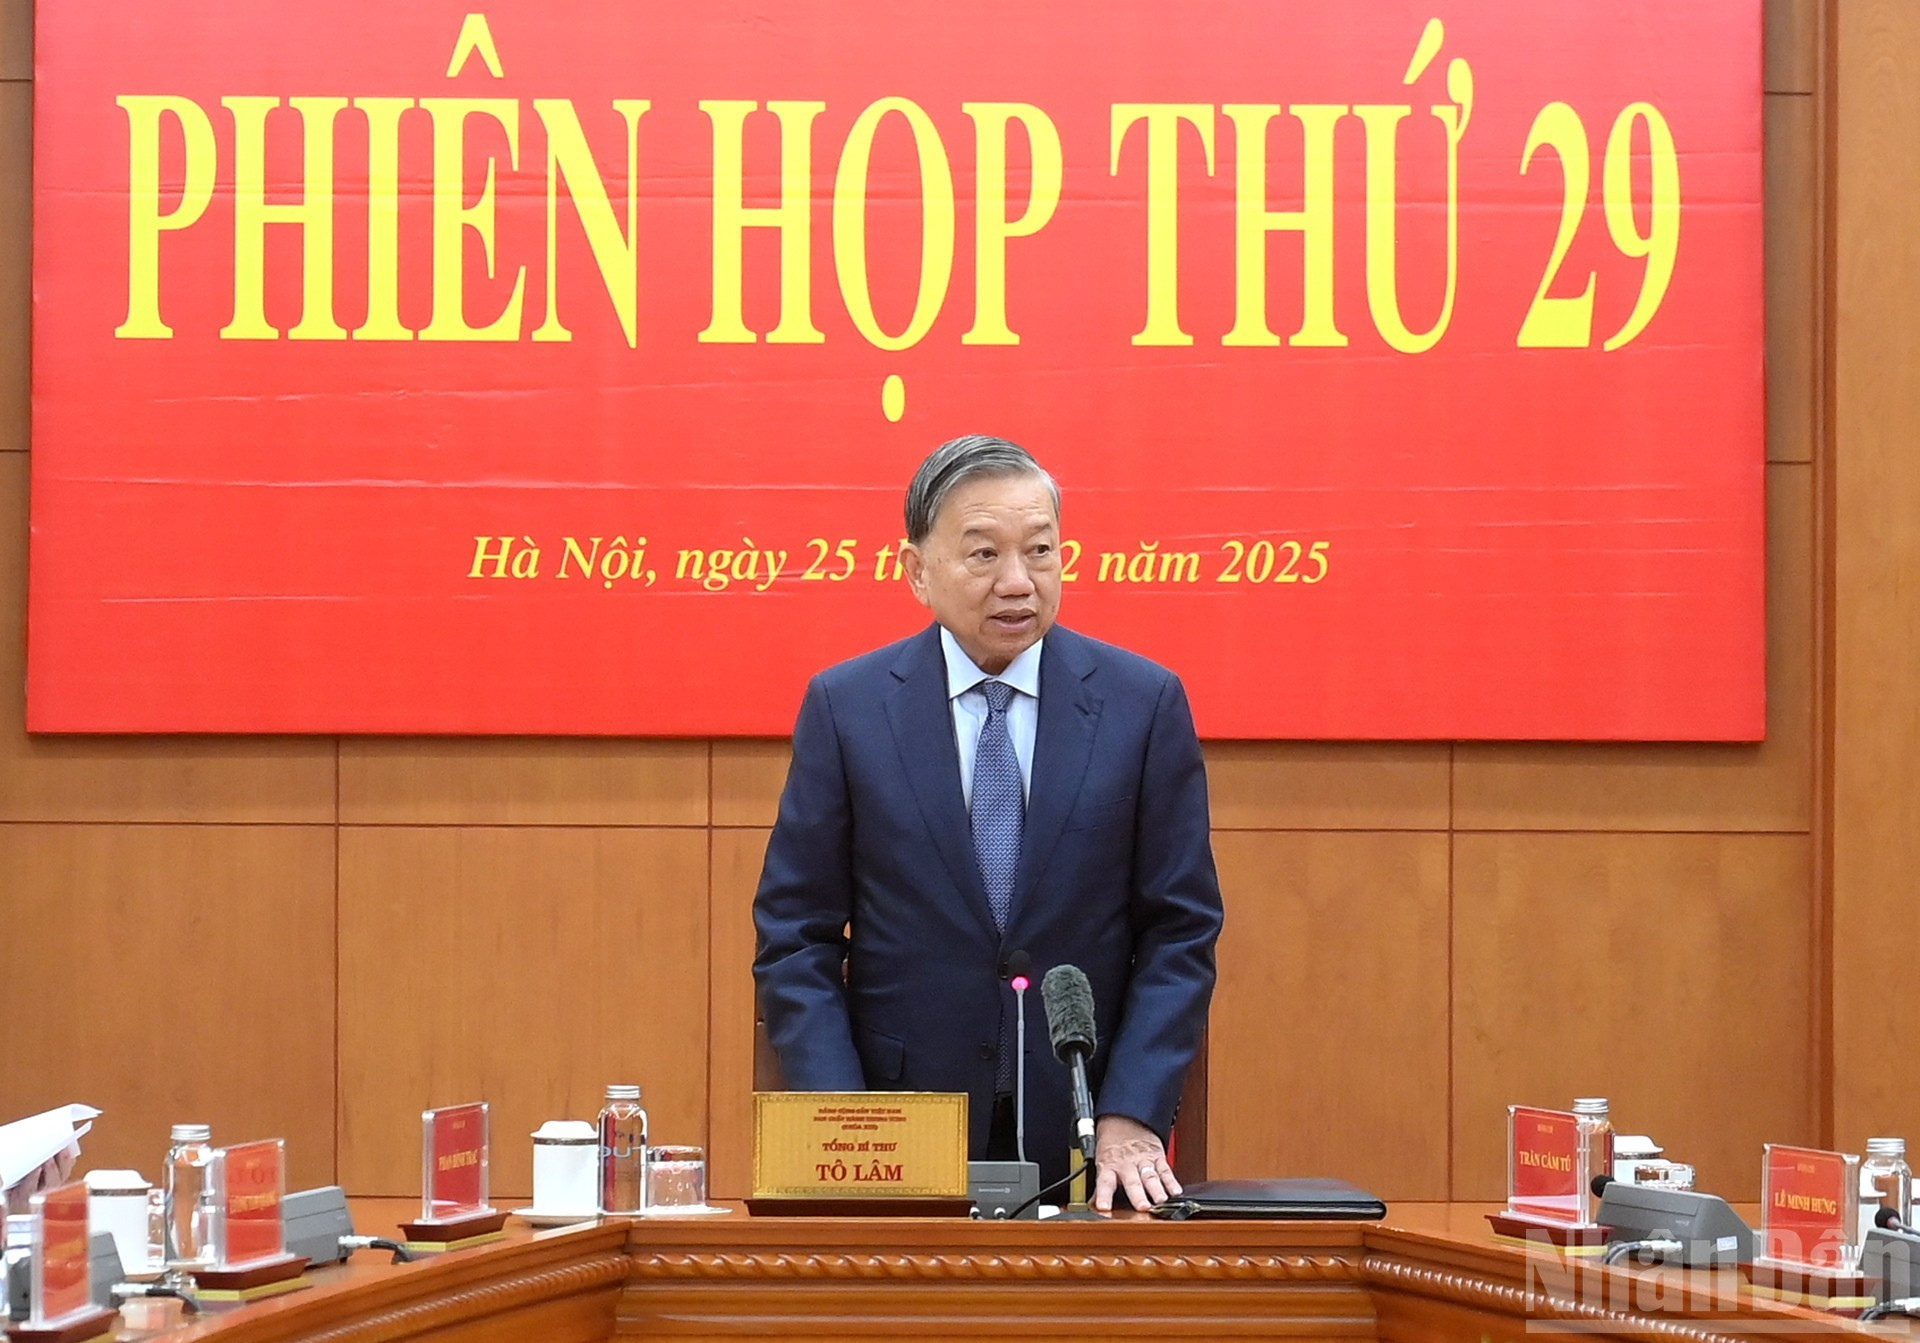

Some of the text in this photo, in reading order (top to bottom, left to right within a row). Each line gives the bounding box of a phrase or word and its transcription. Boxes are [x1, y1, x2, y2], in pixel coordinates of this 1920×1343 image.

[115, 14, 1681, 421] PHIÊN HỌP THỨ 29
[469, 536, 539, 578] Hà
[557, 537, 655, 588] Nội,
[676, 538, 786, 590] ngày
[801, 539, 856, 580] 25
[1099, 542, 1199, 582] năm
[1218, 541, 1329, 583] 2025
[857, 1140, 870, 1152] BÍ
[872, 1142, 898, 1152] THƯ
[815, 1159, 904, 1182] TÔ LÂM
[1519, 1149, 1540, 1167] TRẦN
[1560, 1154, 1572, 1172] TÚ
[1774, 1188, 1837, 1216] LÊ MINH HƯNG
